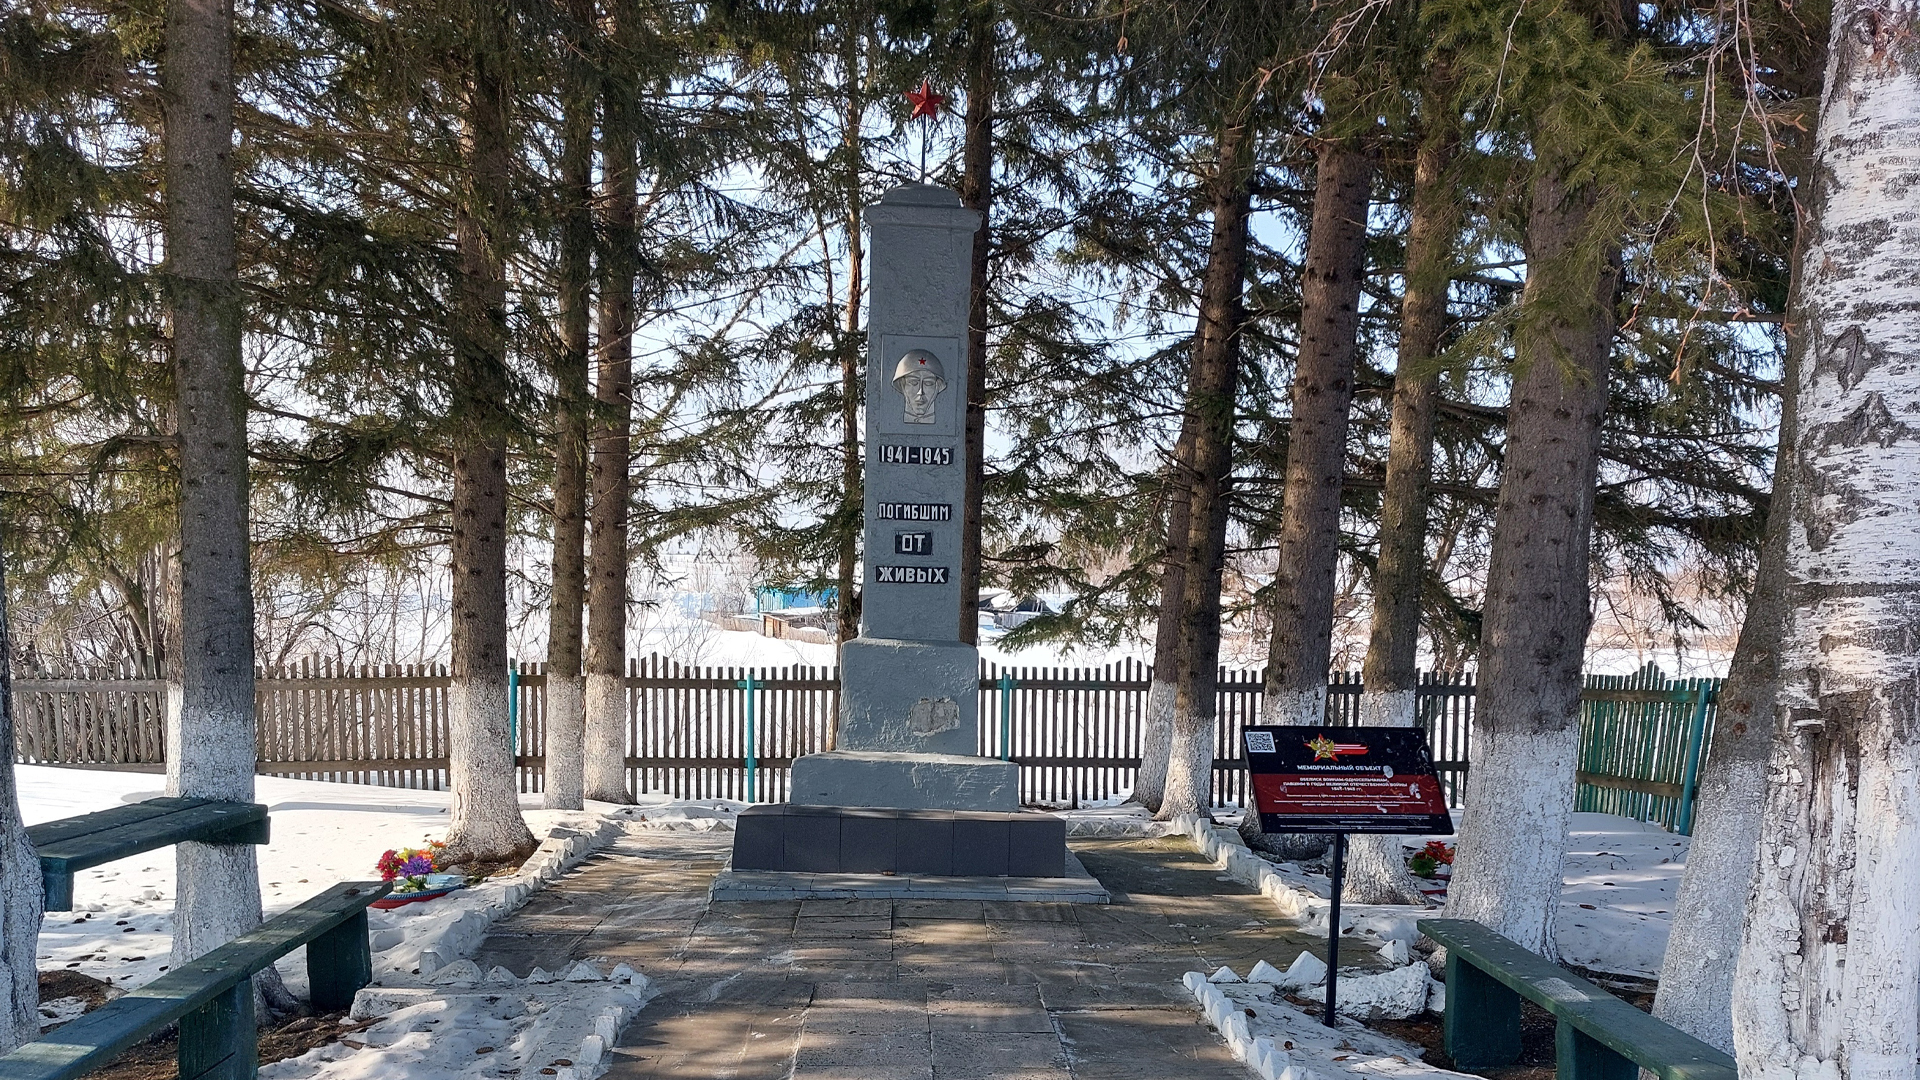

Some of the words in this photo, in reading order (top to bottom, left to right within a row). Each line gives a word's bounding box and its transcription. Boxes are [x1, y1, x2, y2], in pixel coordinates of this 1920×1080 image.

[881, 445, 950, 465] 1941-1945
[878, 503, 949, 520] ПОГИБШИМ
[901, 534, 926, 552] ОТ
[878, 567, 946, 583] ЖИВЫХ
